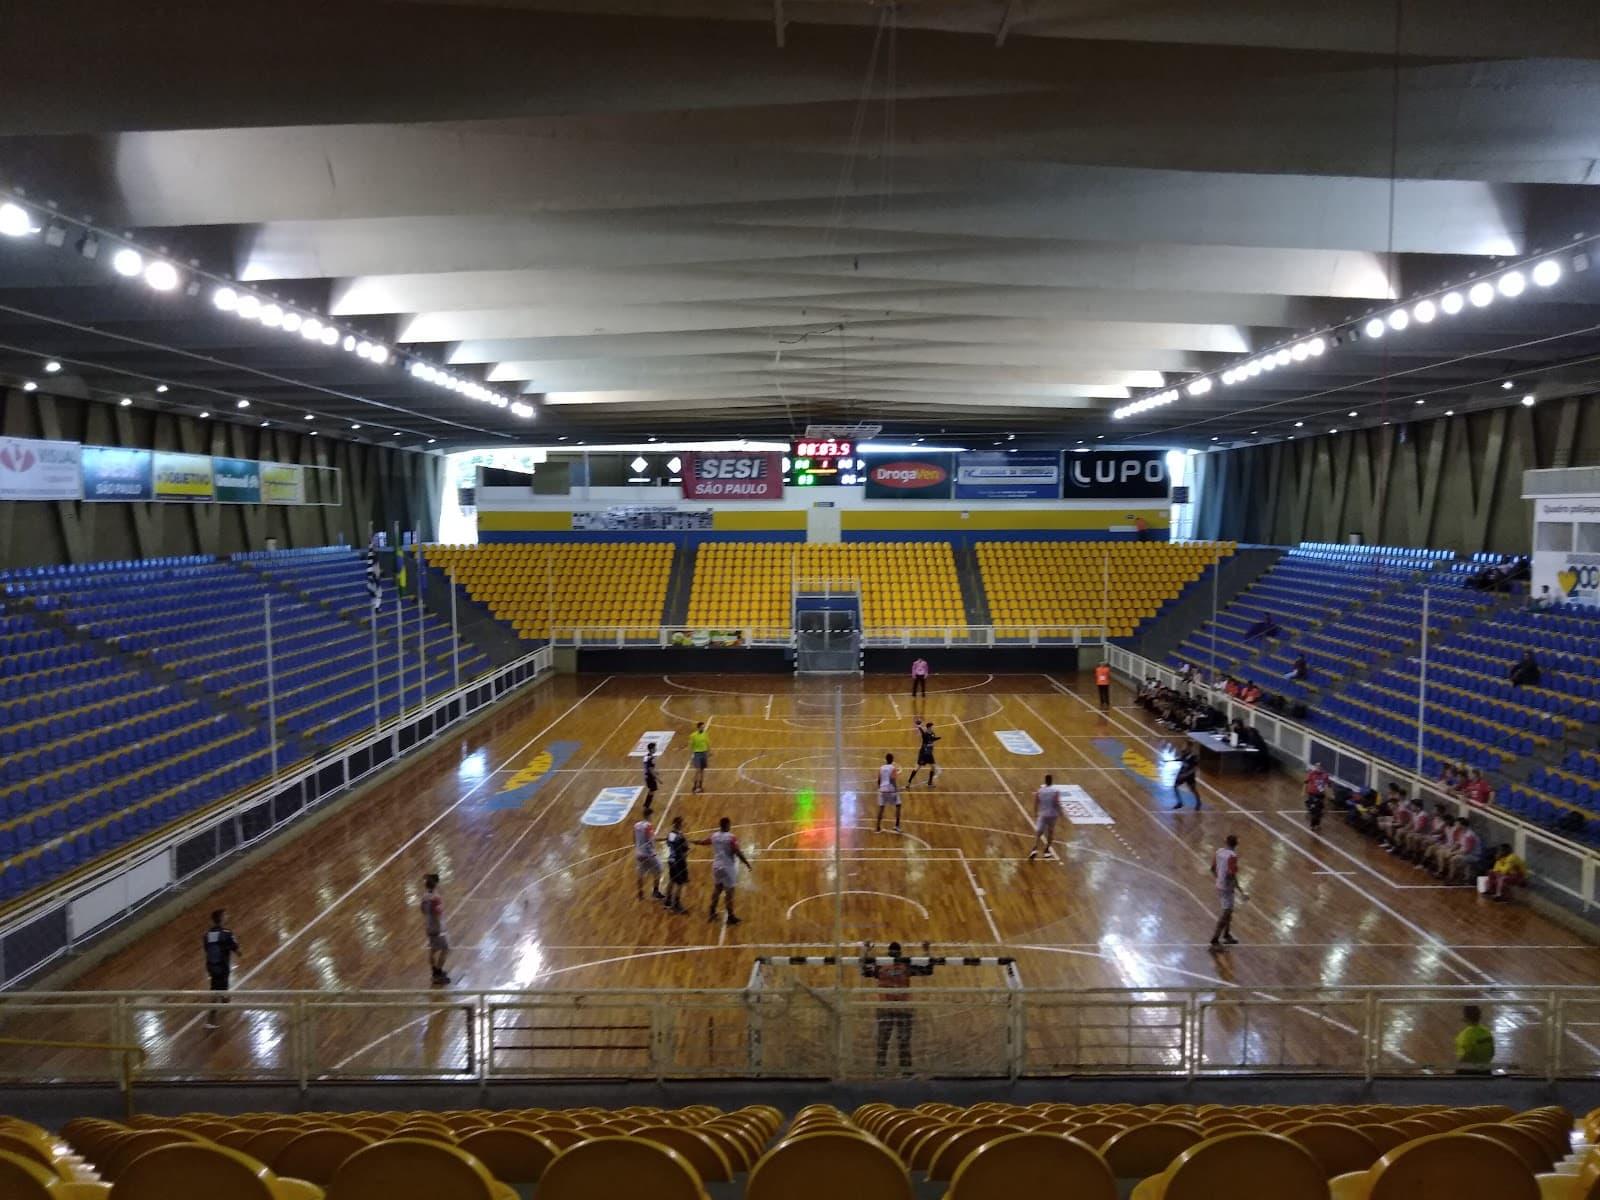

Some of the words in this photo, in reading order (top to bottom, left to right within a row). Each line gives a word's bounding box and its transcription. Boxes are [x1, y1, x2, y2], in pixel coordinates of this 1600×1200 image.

[702, 458, 761, 479] SESI
[877, 468, 940, 483] DrogaVen
[1073, 460, 1164, 484] LUPO
[695, 482, 723, 495] SÃO
[724, 483, 767, 495] PAULO
